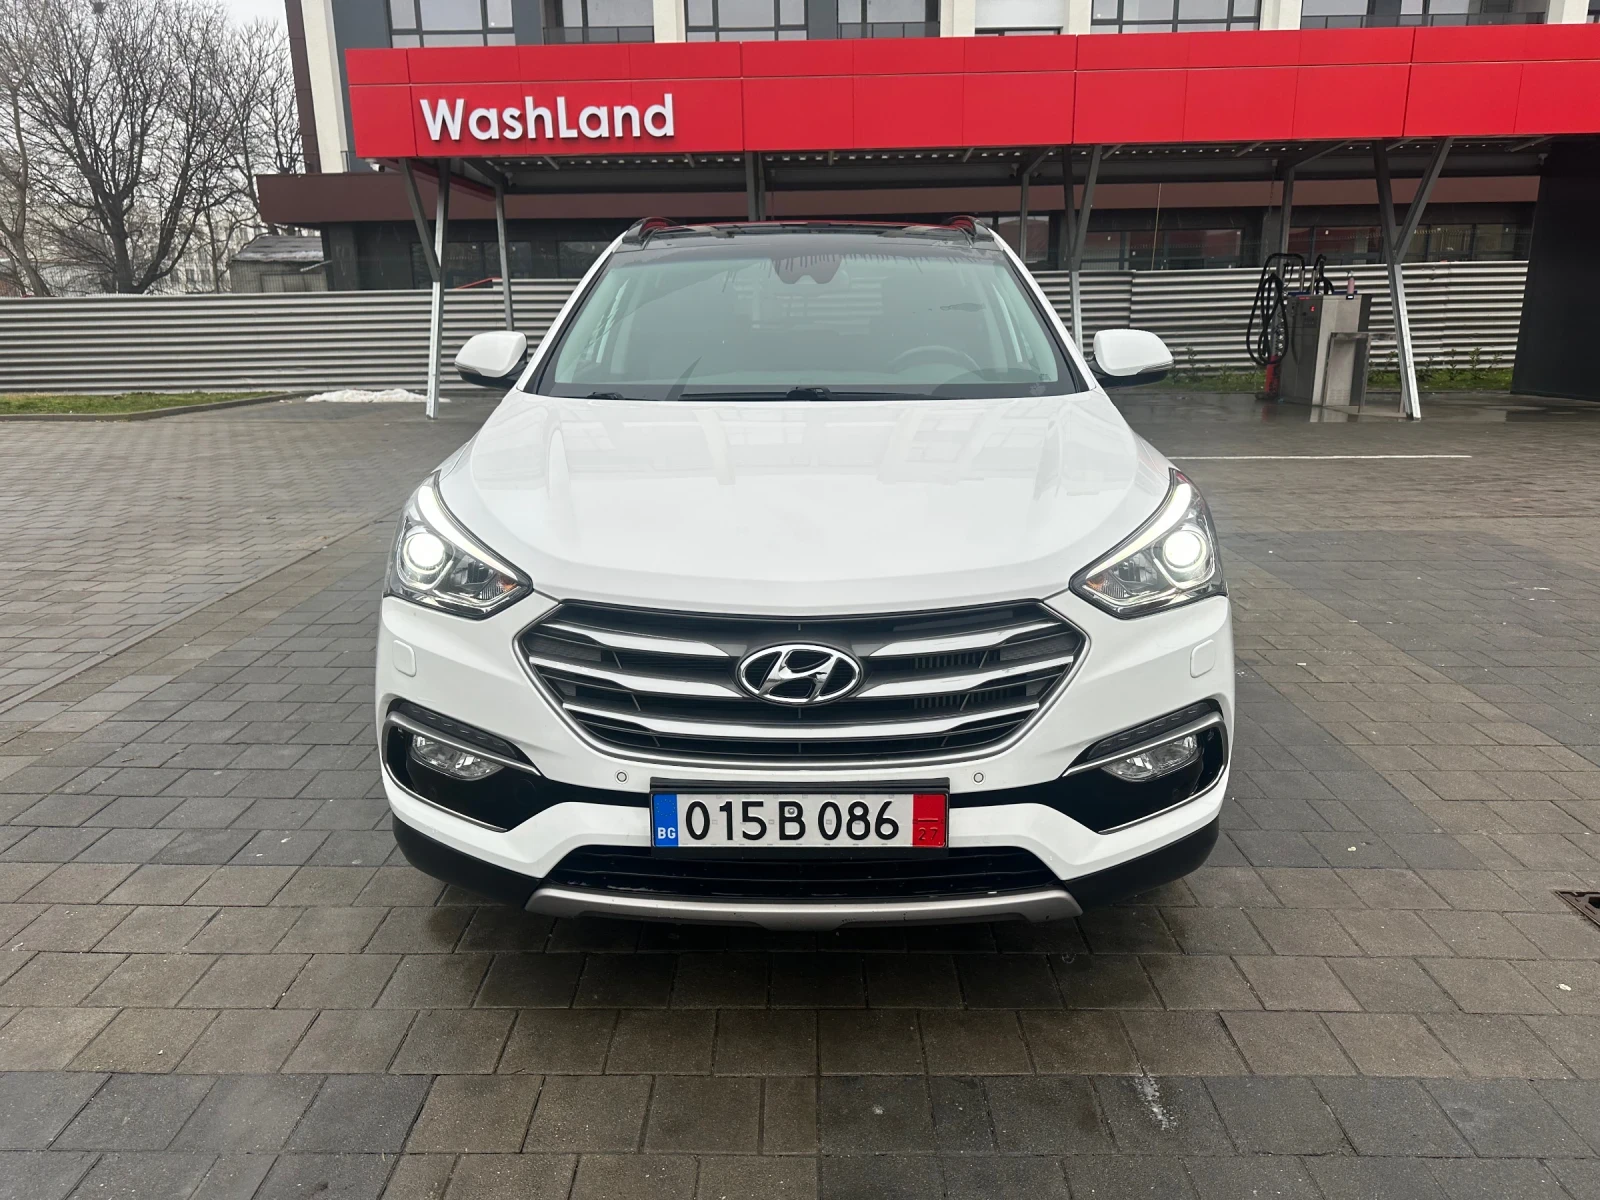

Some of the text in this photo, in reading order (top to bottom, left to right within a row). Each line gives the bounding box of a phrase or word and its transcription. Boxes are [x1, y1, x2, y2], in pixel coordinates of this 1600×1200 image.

[420, 94, 674, 140] WashLand
[658, 827, 675, 839] BG
[918, 827, 938, 841] 27
